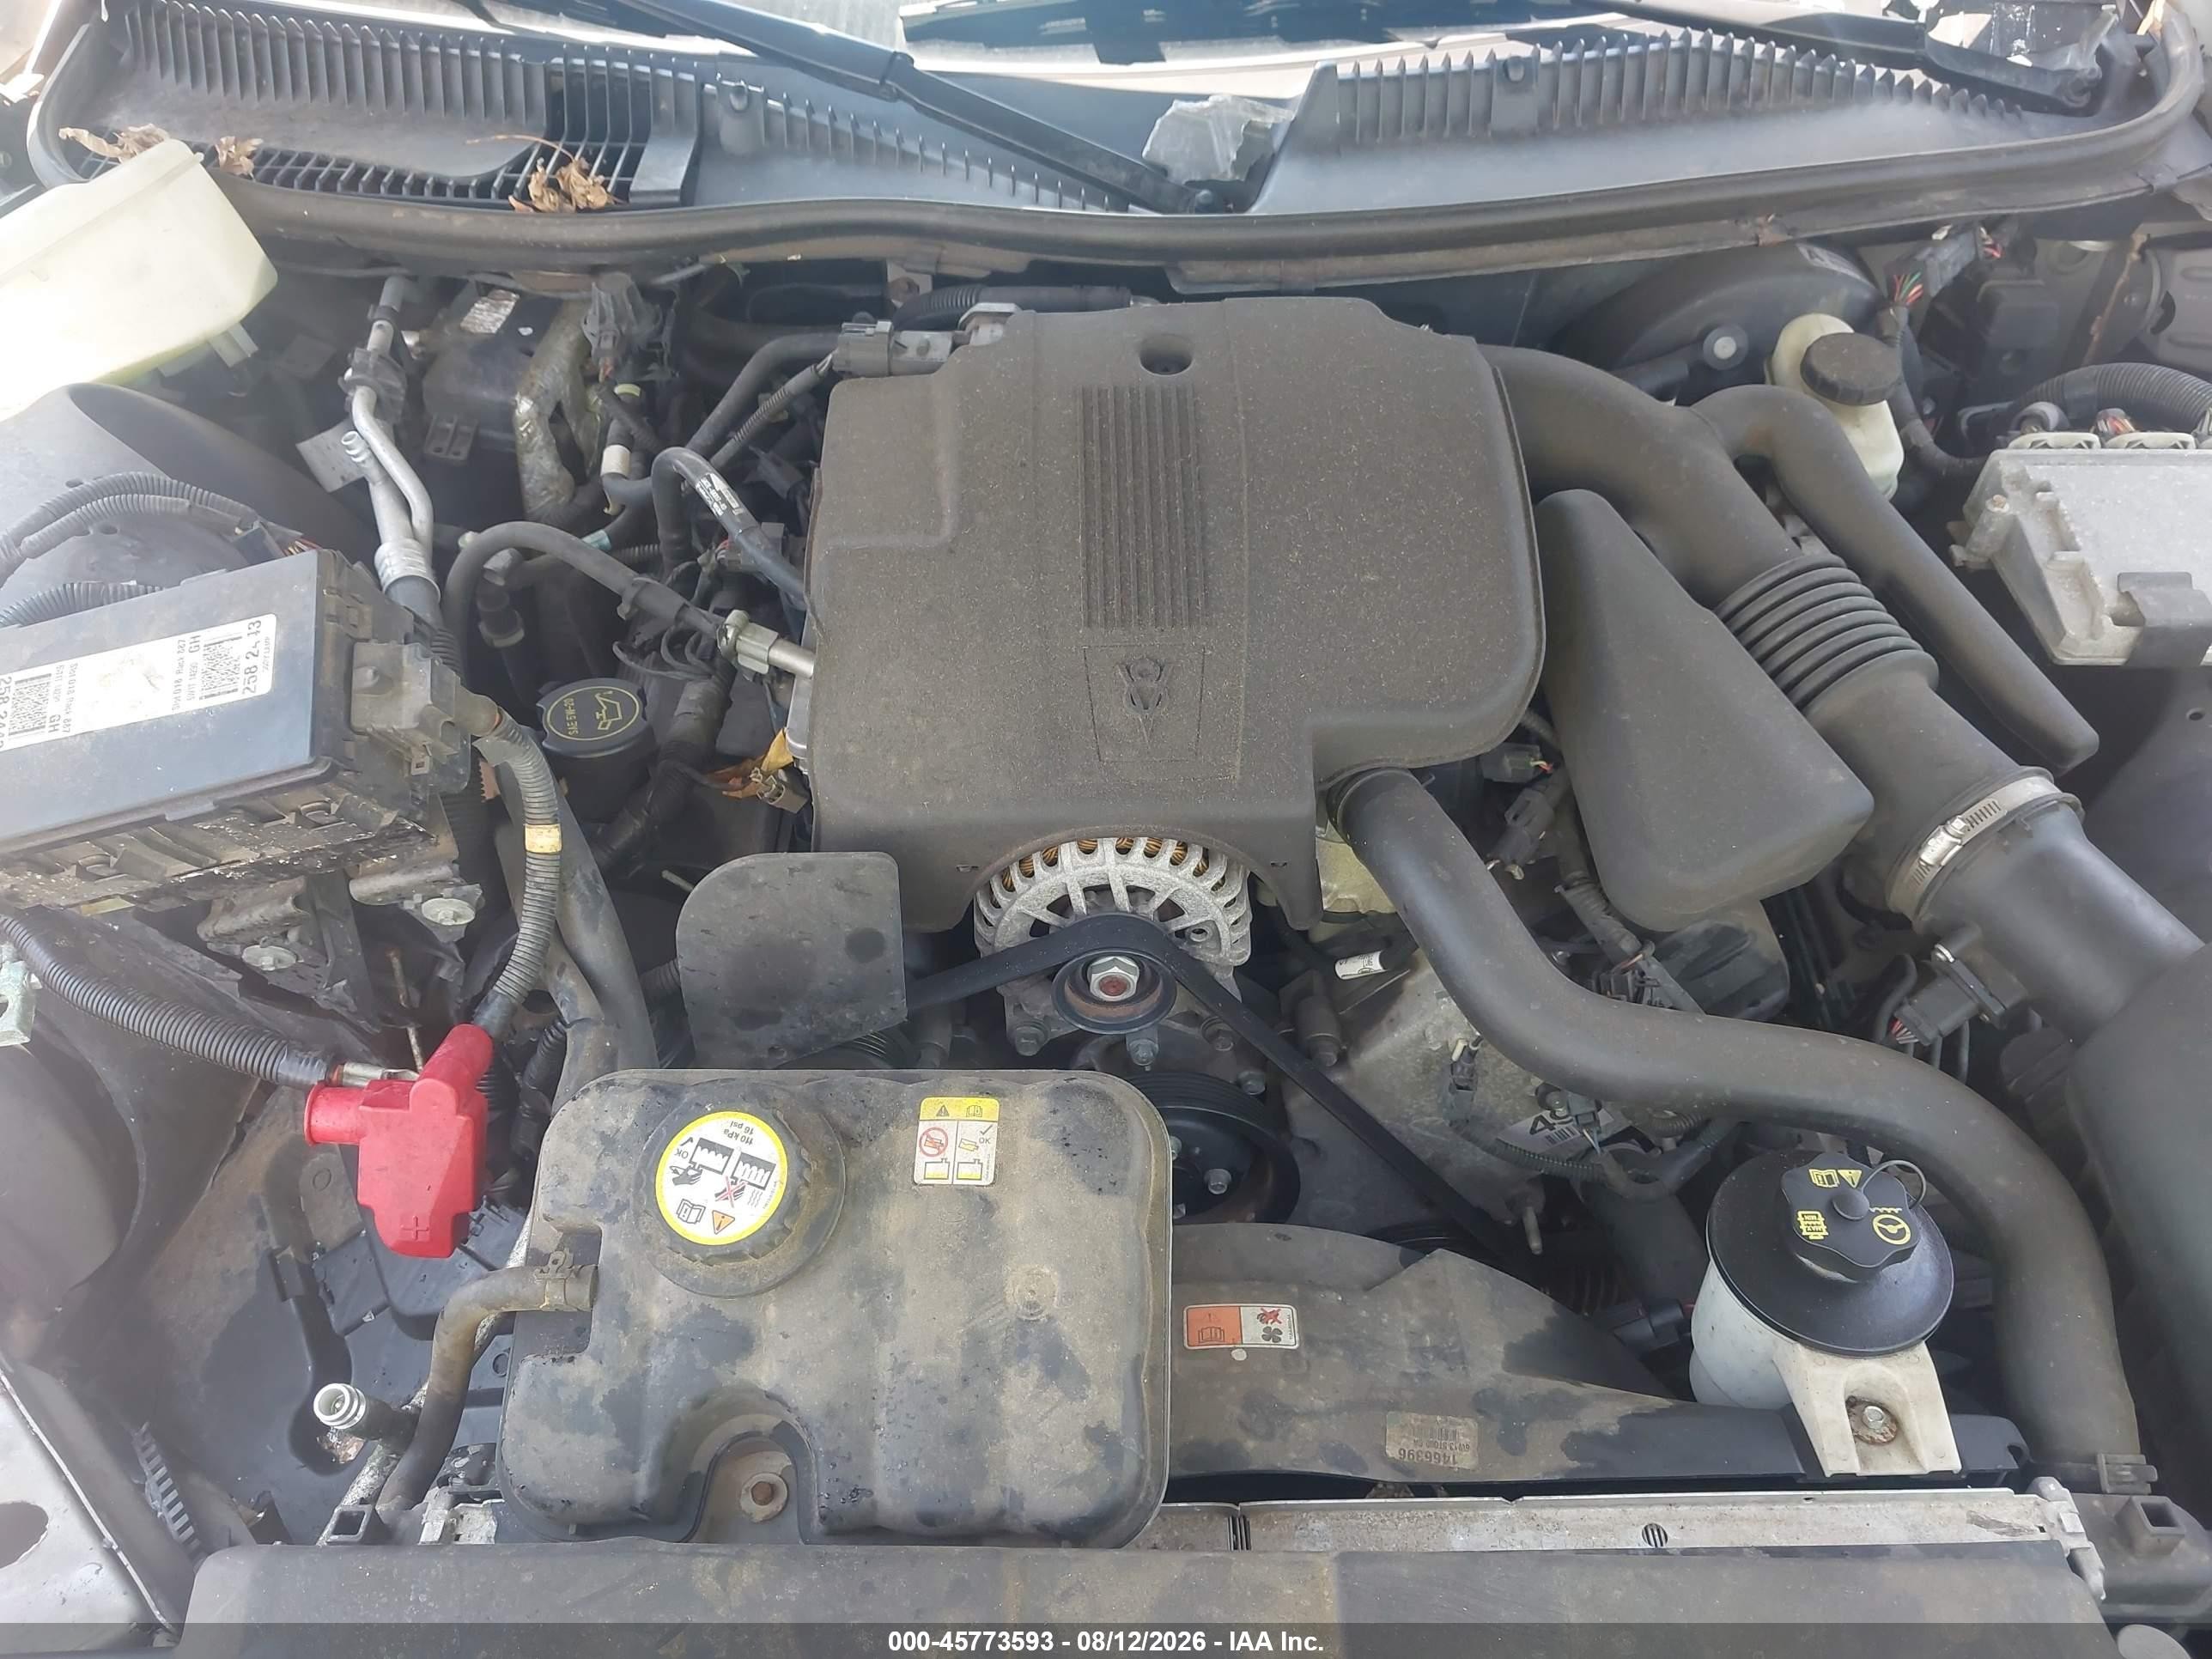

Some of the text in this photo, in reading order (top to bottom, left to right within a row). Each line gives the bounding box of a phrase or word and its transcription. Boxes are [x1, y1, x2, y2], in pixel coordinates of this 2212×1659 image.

[188, 635, 201, 653] GH
[242, 665, 258, 694] 258
[48, 714, 61, 733] GH
[563, 697, 579, 736] SAE 5W-20
[723, 1128, 754, 1146] 110 kPa
[729, 1121, 755, 1135] 16 psi
[675, 1148, 689, 1159] OK
[1398, 1448, 1459, 1465] 1466396
